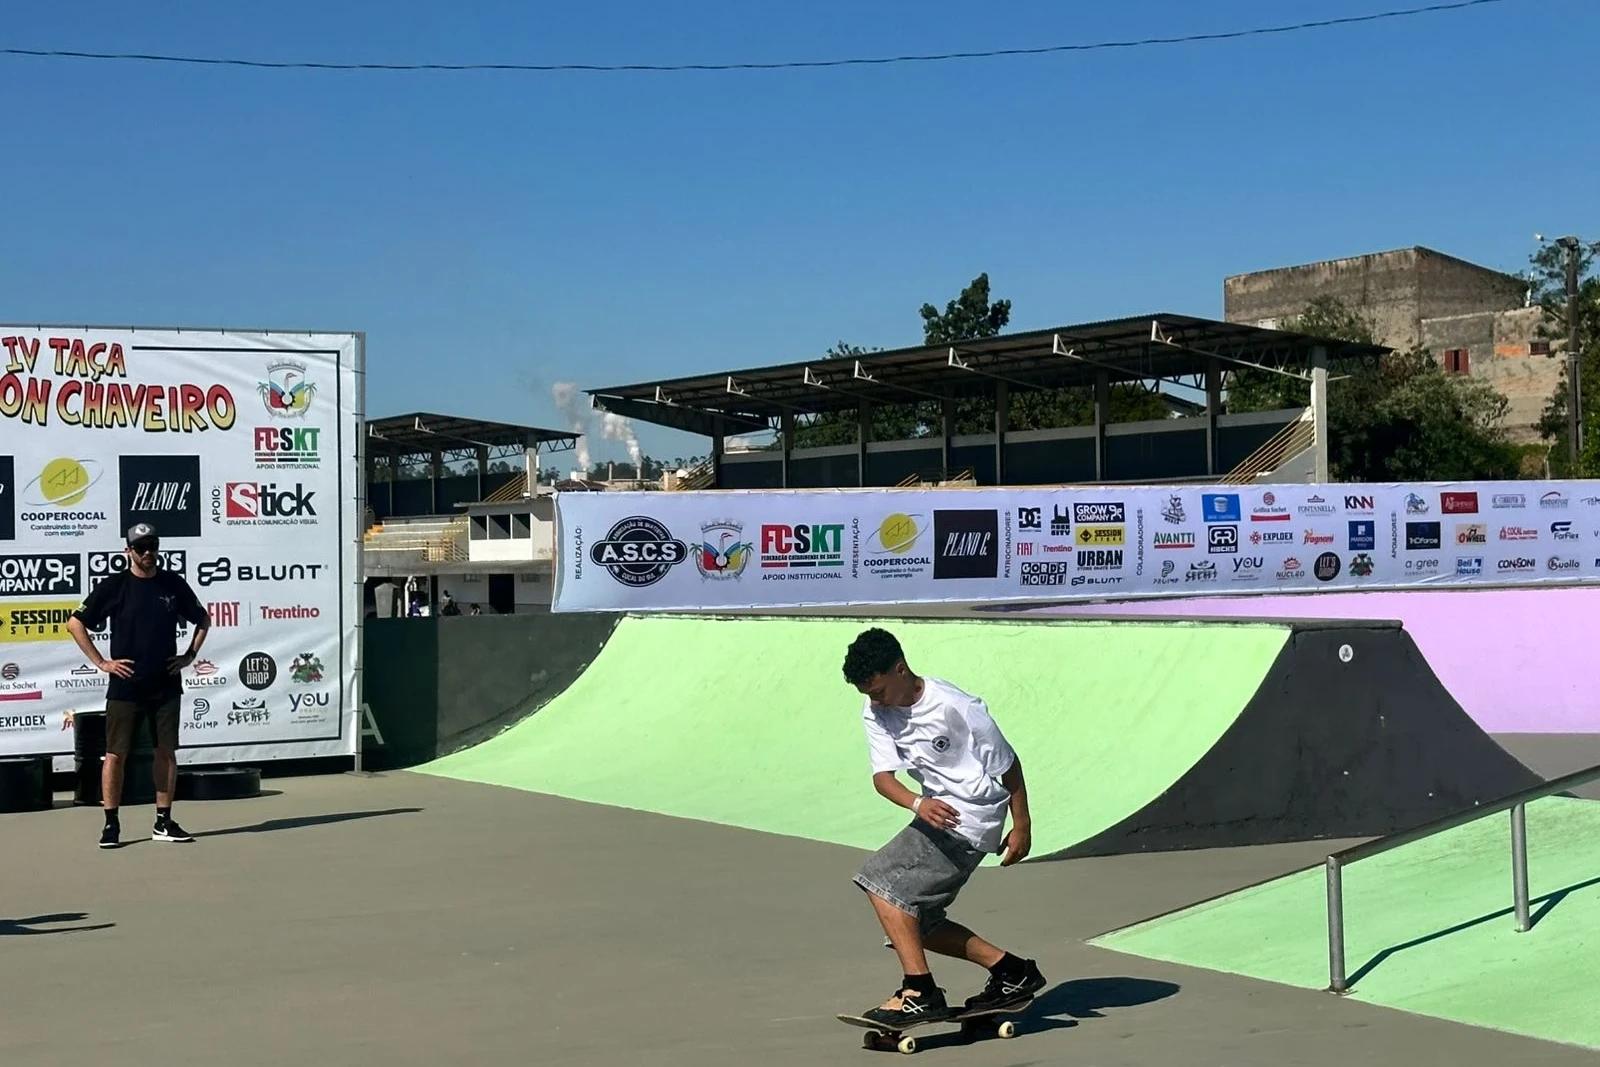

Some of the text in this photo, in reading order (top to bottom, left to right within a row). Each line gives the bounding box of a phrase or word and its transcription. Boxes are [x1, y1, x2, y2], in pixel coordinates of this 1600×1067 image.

[2, 336, 127, 381] IV TAÇA
[56, 380, 236, 433] CHAVEIRO
[254, 427, 320, 451] FCSKT
[130, 482, 177, 511] PLANO
[227, 483, 317, 517] Stick
[1344, 496, 1374, 509] KNN
[21, 511, 107, 521] COOPERCOCAL
[1076, 505, 1108, 514] GROW
[1297, 505, 1336, 513] FONTANELLA
[761, 524, 845, 554] FCSKT
[1154, 532, 1195, 544] AVANTTI
[1263, 532, 1293, 541] EXPLOEX
[942, 532, 979, 557] PLANO
[1017, 543, 1073, 556] FIAT Trentino
[601, 543, 677, 562] A.S.C.S
[1077, 550, 1123, 566] URBAN
[0, 559, 42, 578] OW
[863, 557, 931, 567] COOPERCOCAL
[237, 564, 322, 581] BLUNT
[762, 572, 842, 581] APOIO INSTITUCIONAL
[1020, 573, 1066, 585] HOUSE
[11, 609, 73, 625] SESSION
[207, 602, 240, 627] FIAT
[260, 605, 320, 620] Trentino
[11, 625, 59, 635] STOR
[246, 657, 269, 671] LET'S
[55, 678, 108, 689] FONTANELL
[246, 671, 270, 685] DROP
[12, 681, 37, 690] Sachet
[0, 714, 46, 728] EXPLOEX
[184, 720, 218, 730] PROIMP
